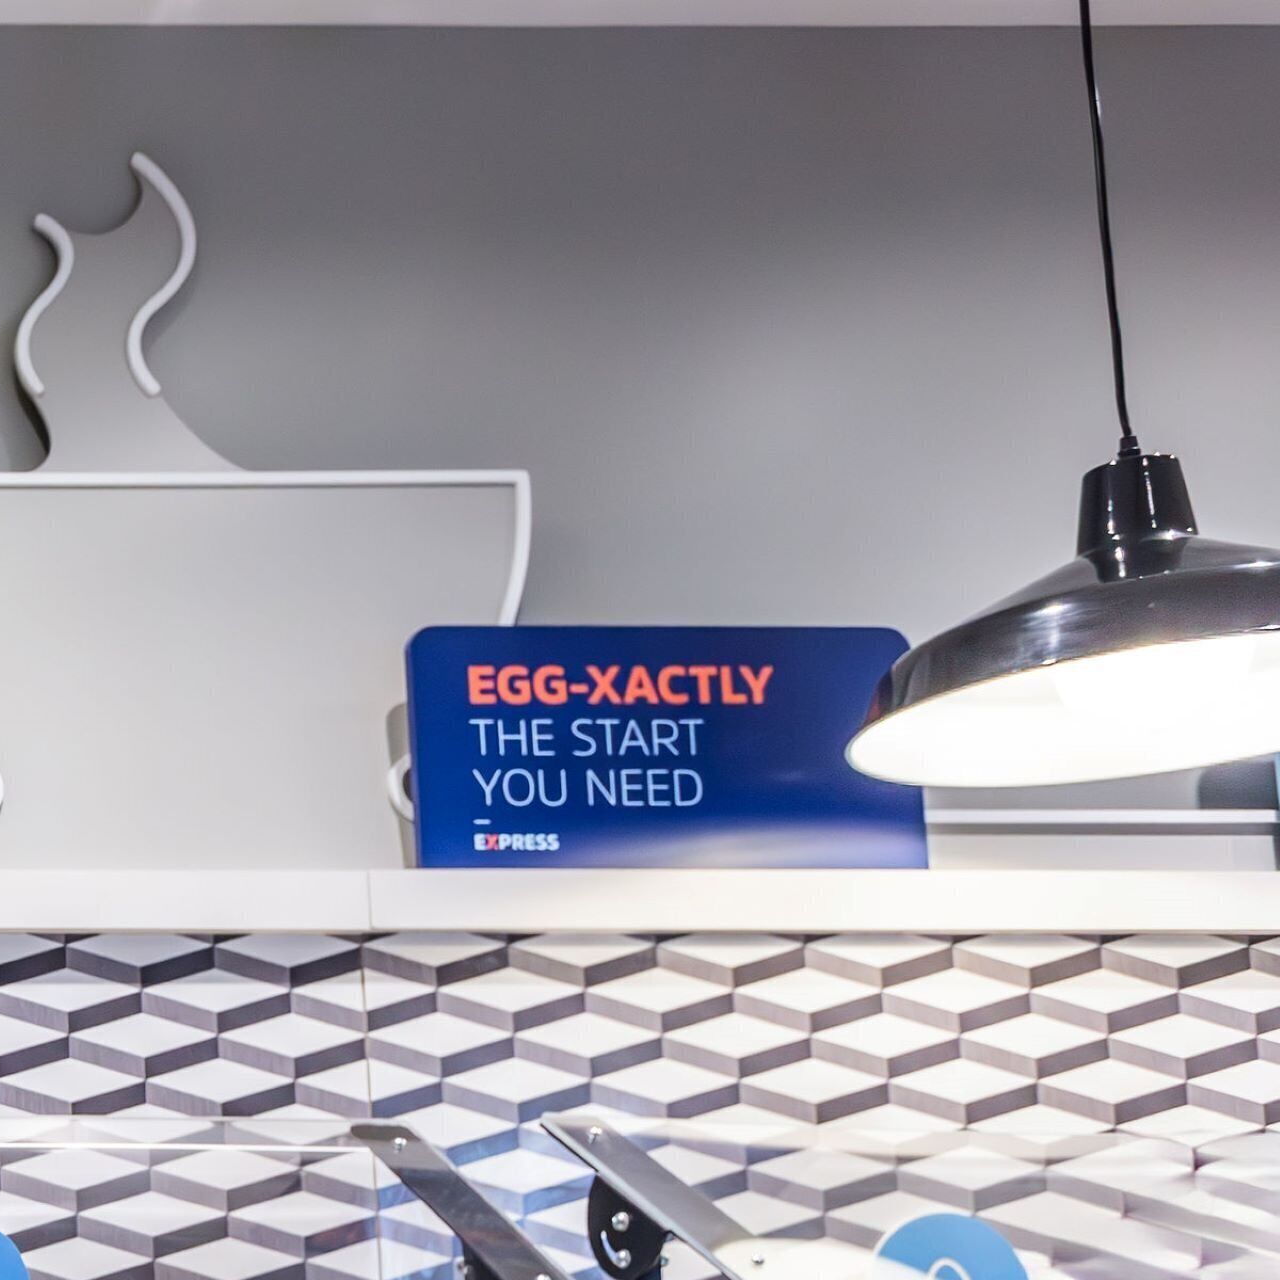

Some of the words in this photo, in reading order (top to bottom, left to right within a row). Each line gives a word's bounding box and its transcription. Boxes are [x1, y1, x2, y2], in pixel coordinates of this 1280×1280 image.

[467, 664, 774, 706] EGG-XACTLY
[468, 717, 557, 758] THE
[571, 717, 706, 758] START
[472, 767, 568, 807] YOU
[586, 767, 705, 807] NEED
[473, 833, 561, 852] EXPRESS
